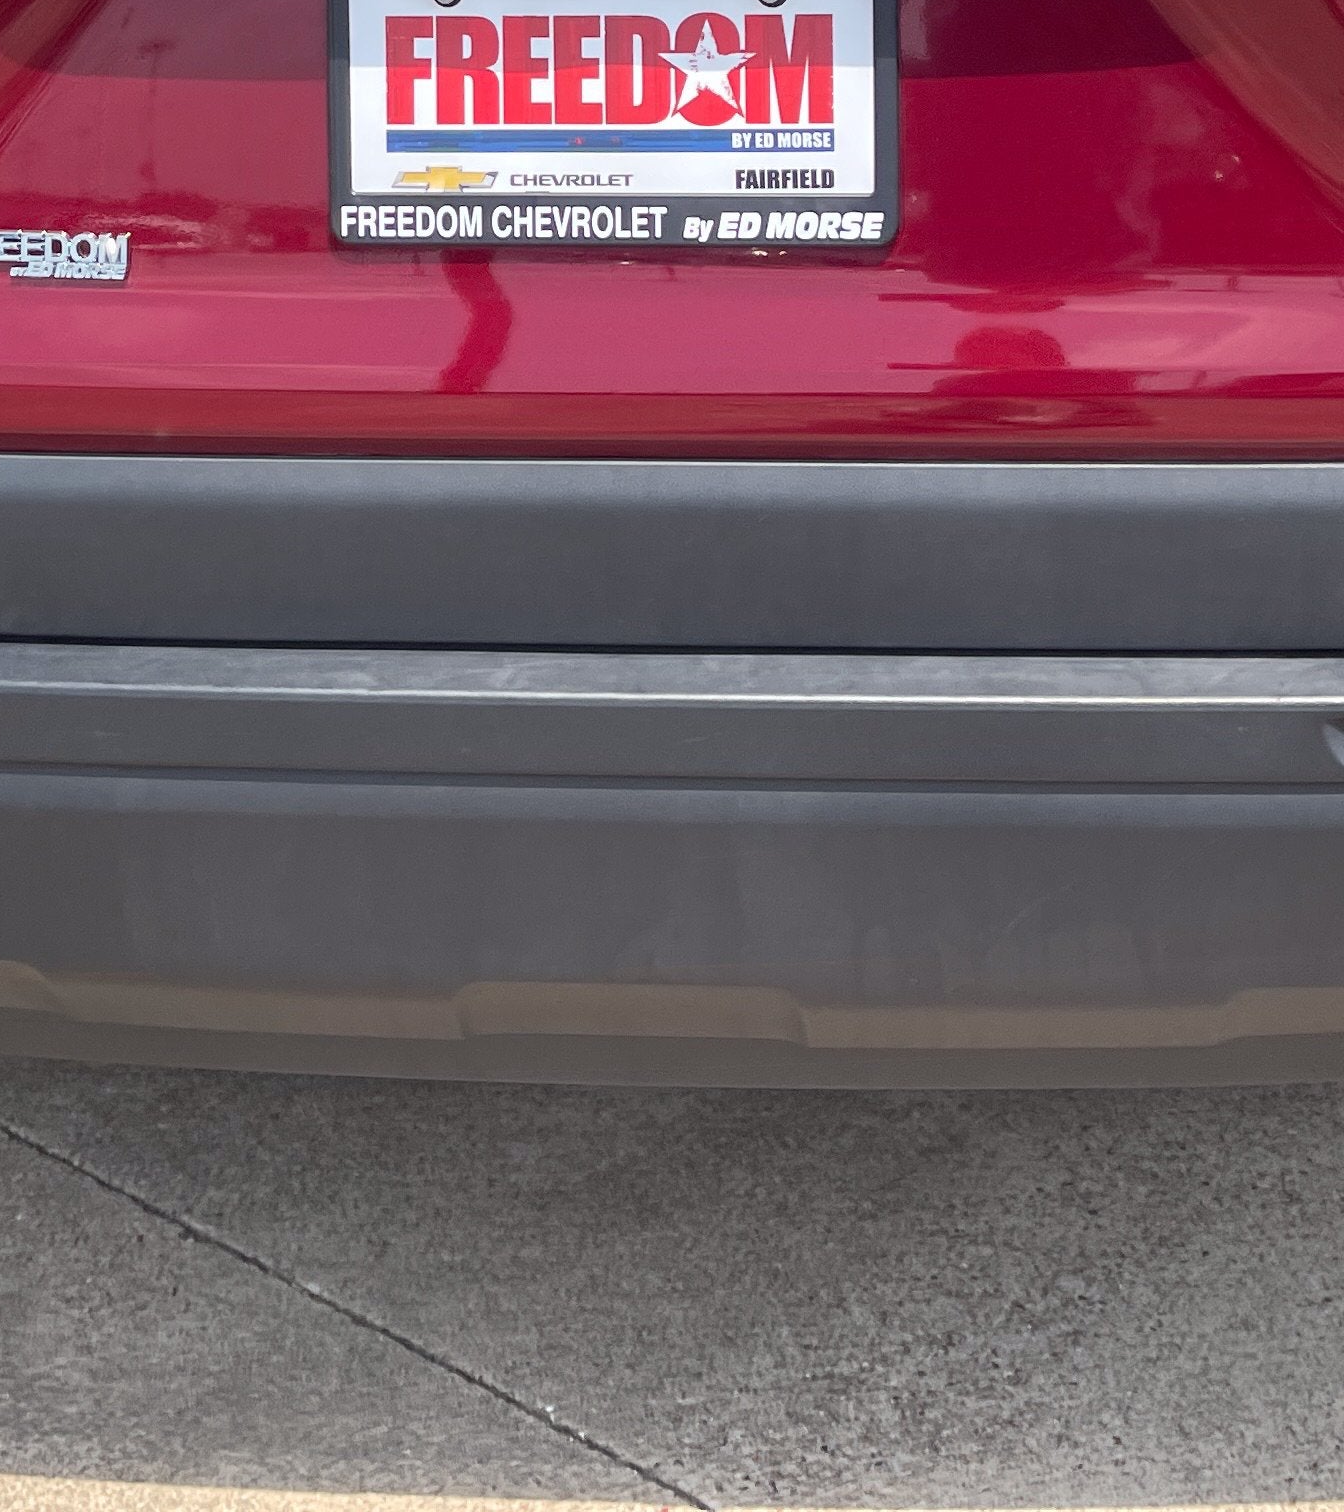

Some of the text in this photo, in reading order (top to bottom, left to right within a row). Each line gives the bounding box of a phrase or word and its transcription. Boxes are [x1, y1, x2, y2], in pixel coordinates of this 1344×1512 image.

[385, 12, 834, 127] FREEDOM
[731, 132, 831, 148] BY ED MORSE
[510, 173, 634, 187] CHEVROLET
[735, 169, 835, 189] FAIRFIELD
[340, 205, 885, 242] FREEDOM CHEVROLET By ED MORSE
